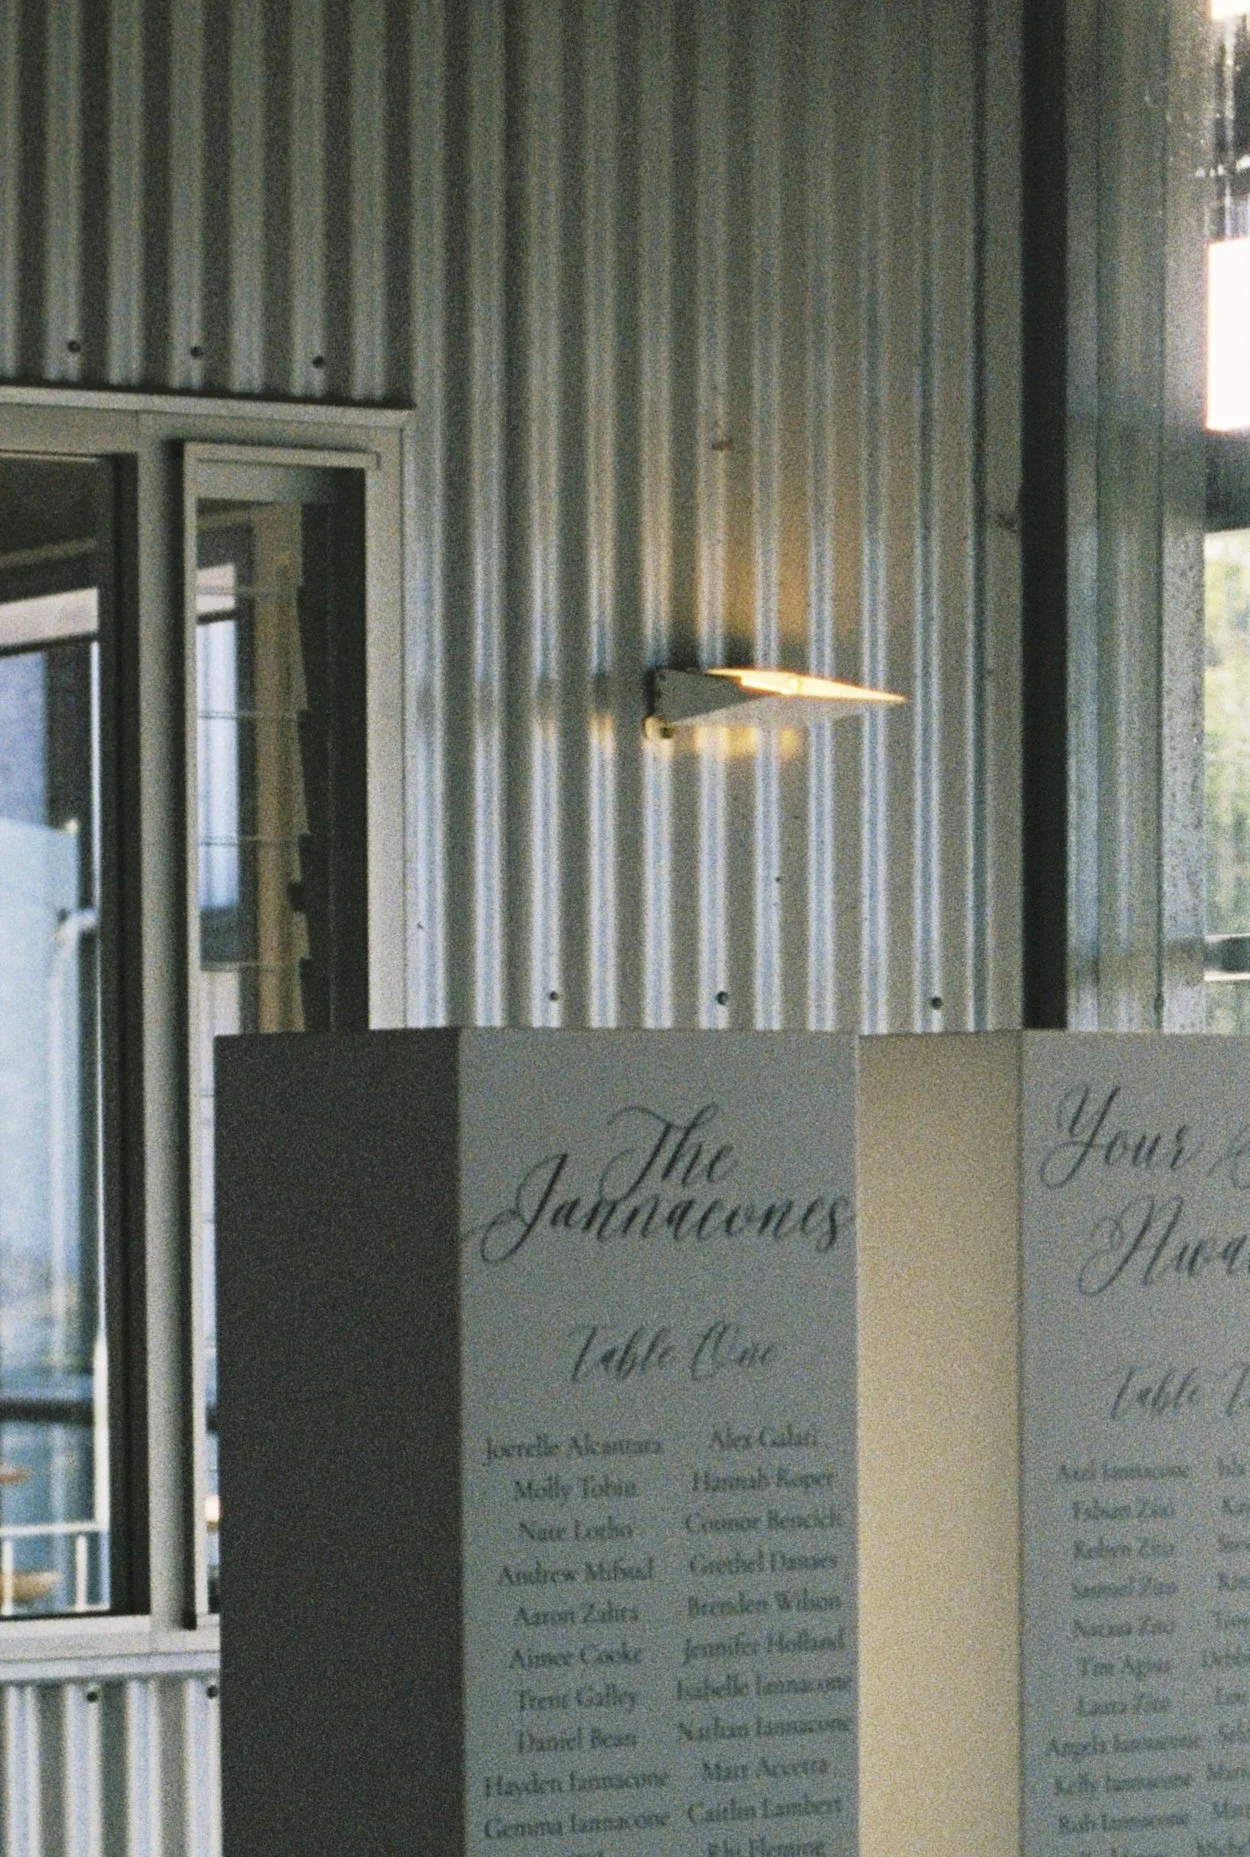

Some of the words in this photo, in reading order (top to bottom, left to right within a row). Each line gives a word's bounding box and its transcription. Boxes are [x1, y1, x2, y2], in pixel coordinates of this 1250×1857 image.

[598, 1104, 738, 1203] The
[1041, 1085, 1195, 1190] Your
[569, 1324, 672, 1383] Table
[691, 1319, 775, 1382] One
[1103, 1365, 1200, 1420] Table
